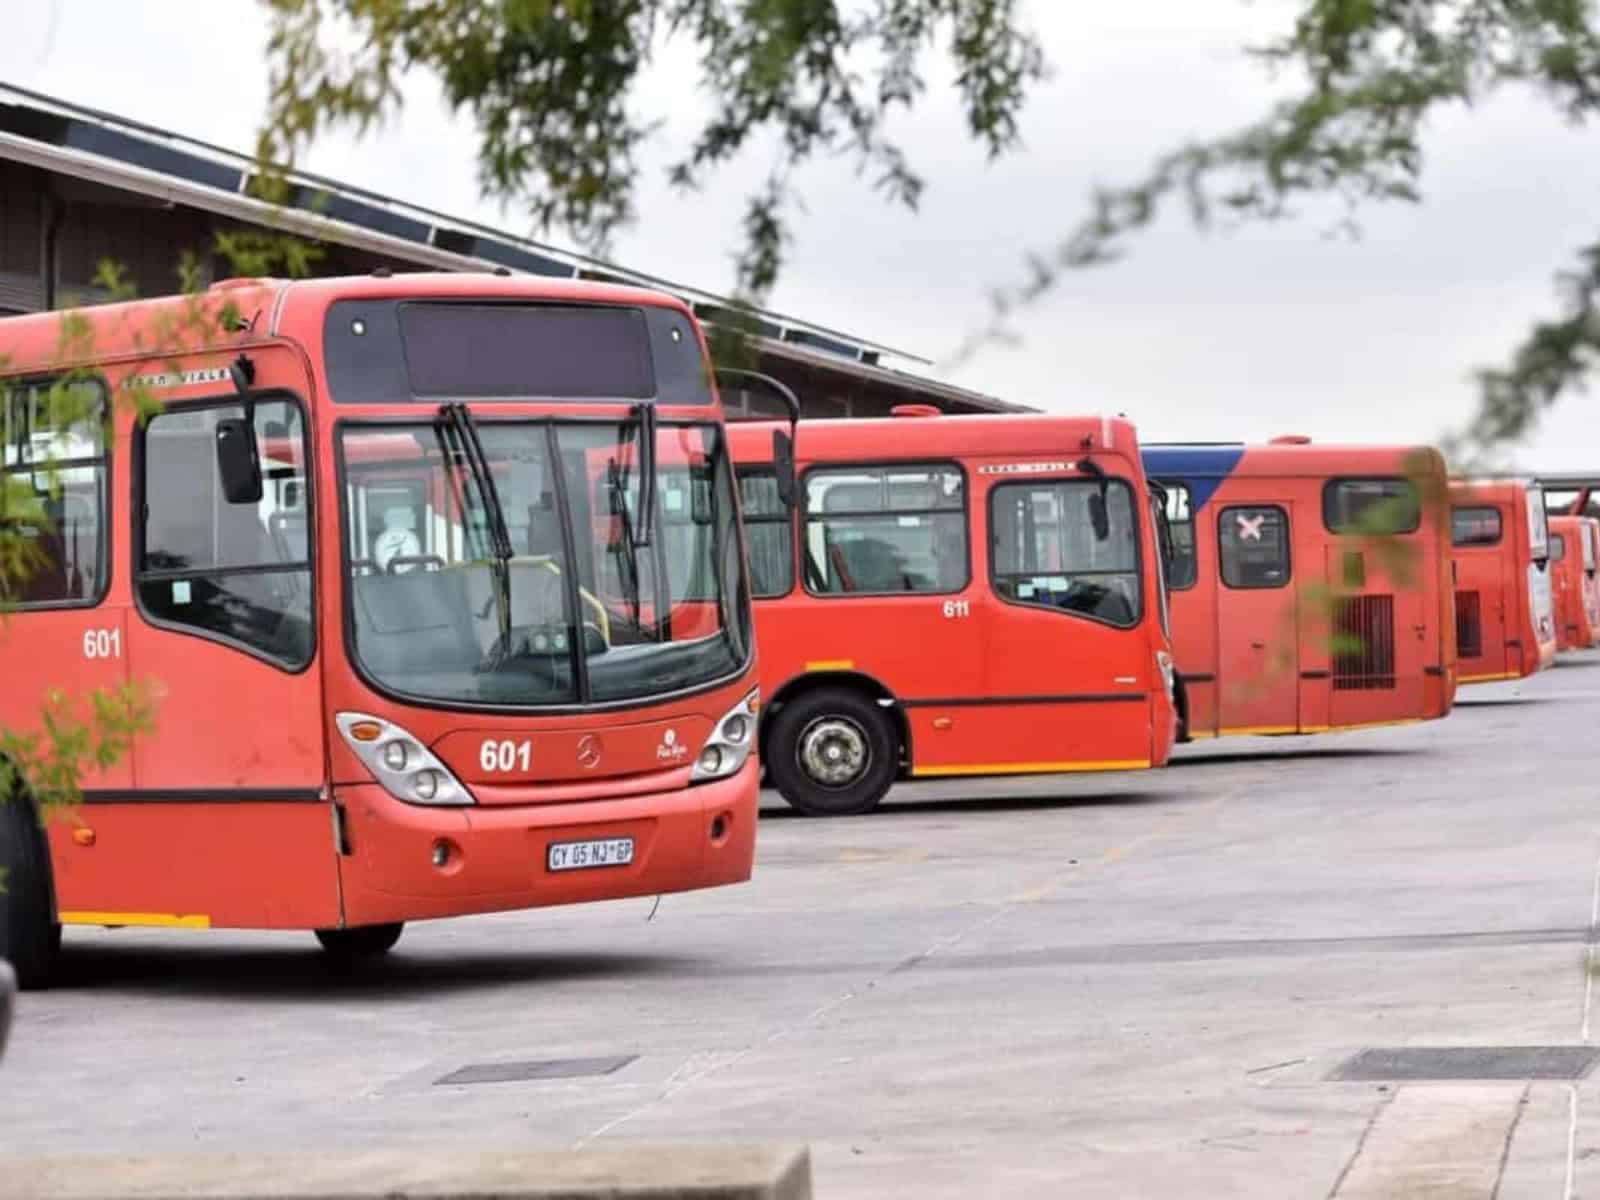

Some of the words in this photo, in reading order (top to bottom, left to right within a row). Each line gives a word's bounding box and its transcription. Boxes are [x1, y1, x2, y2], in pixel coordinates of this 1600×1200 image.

[943, 600, 969, 618] 611
[83, 627, 121, 658] 601
[480, 739, 532, 772] 601
[552, 846, 568, 866] CY
[572, 844, 588, 864] 05
[591, 843, 608, 862] NJ
